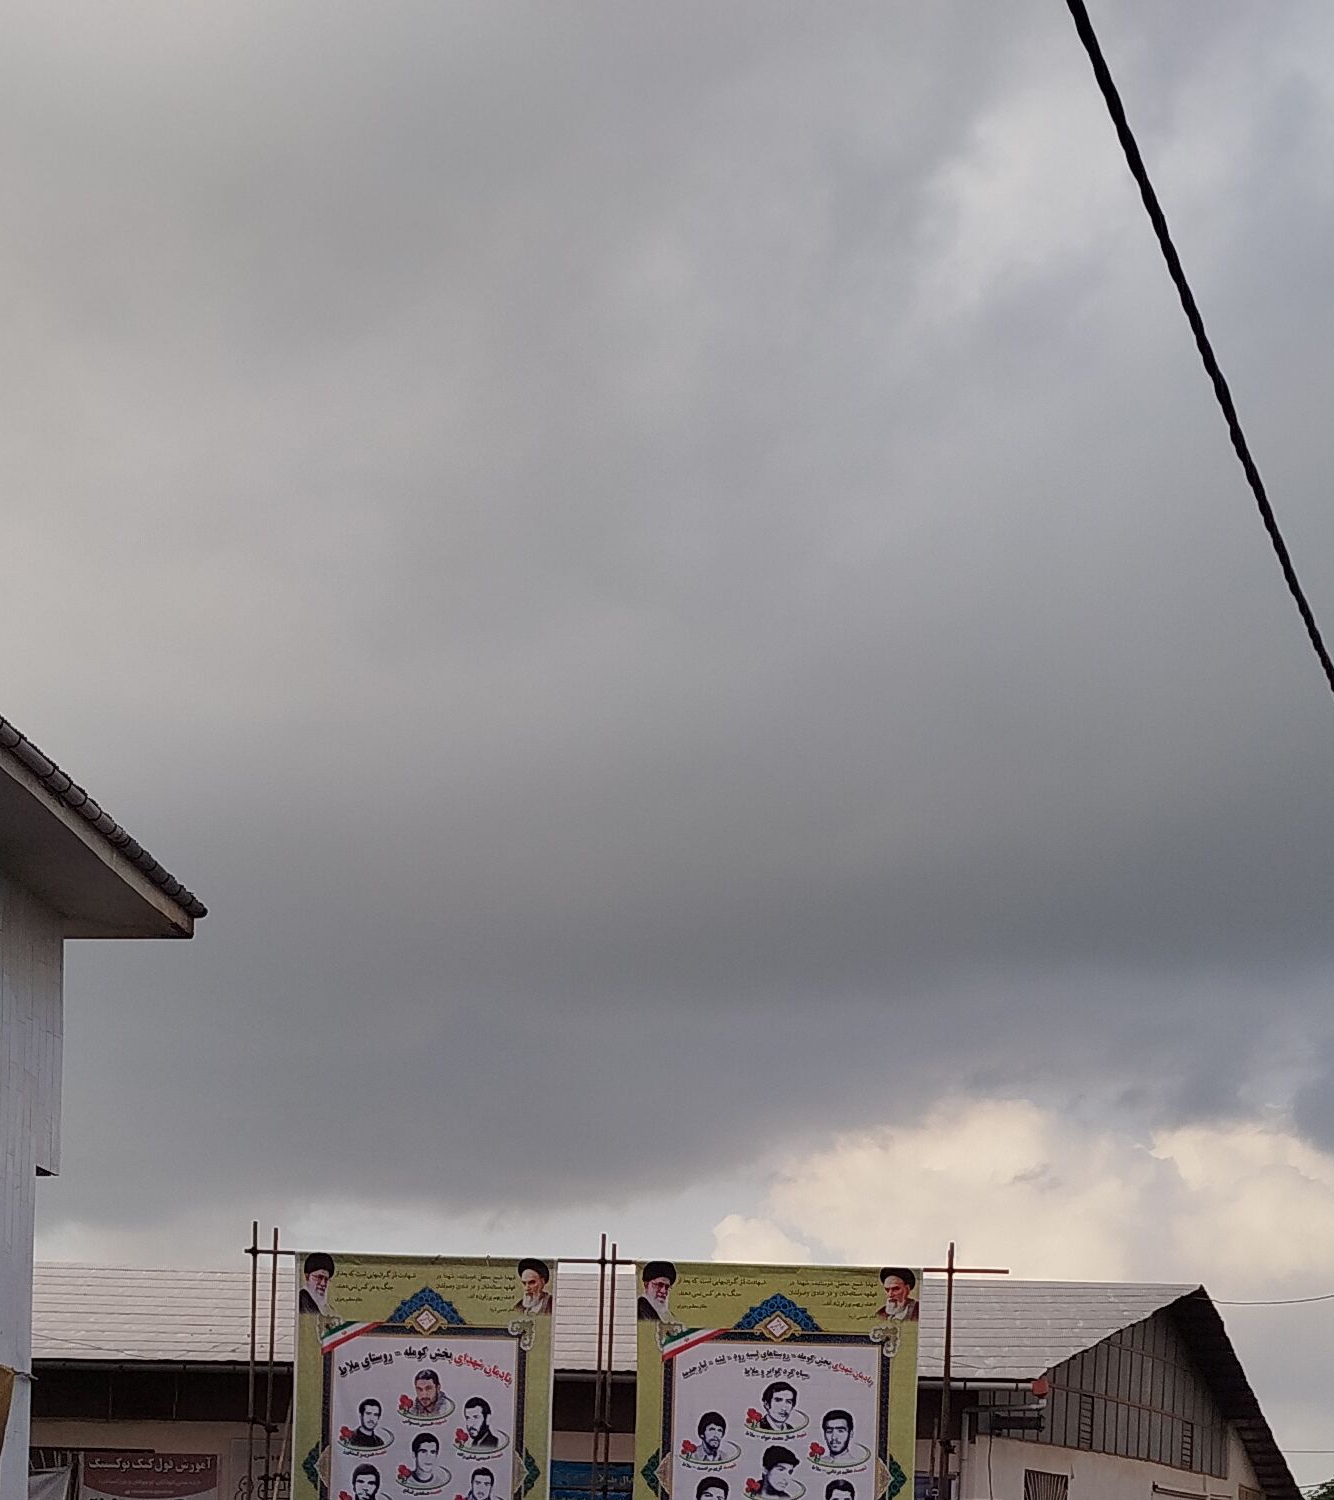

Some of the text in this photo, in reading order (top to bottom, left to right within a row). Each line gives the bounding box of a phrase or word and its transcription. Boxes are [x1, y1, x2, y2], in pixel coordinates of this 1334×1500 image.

[362, 1351, 394, 1370] روستای
[404, 1345, 429, 1362] کومله
[429, 1350, 453, 1364] بخش
[88, 1457, 131, 1473] بوکسینگ
[154, 1457, 175, 1473] فول
[175, 1456, 212, 1473] آموزش
